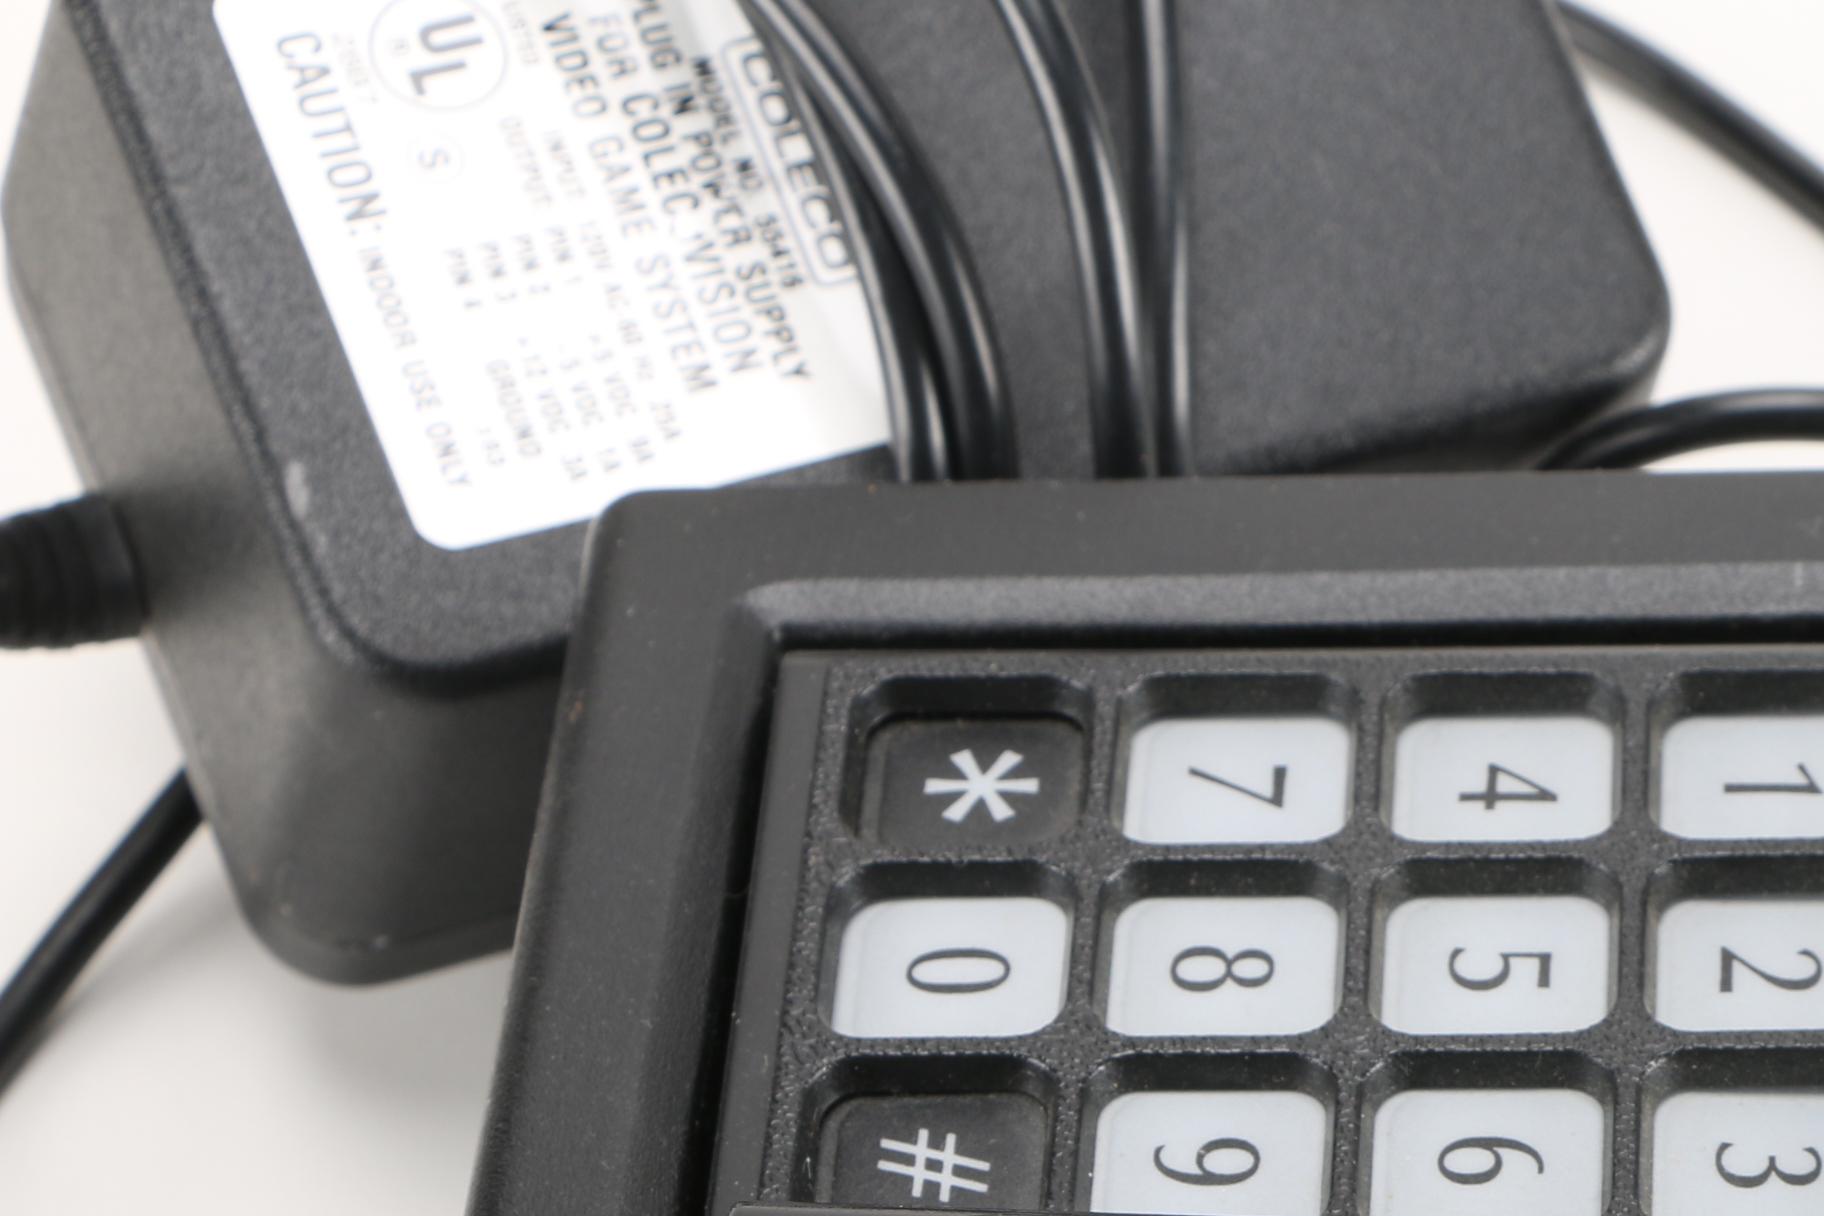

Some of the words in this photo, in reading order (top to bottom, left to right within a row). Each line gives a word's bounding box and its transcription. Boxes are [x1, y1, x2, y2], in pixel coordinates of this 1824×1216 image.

[407, 13, 484, 97] UL
[690, 57, 740, 142] MODEL
[540, 11, 608, 115] VIDEO
[589, 134, 654, 236] GAME
[636, 255, 719, 393] SYSTEM
[591, 17, 638, 80] FOR
[619, 91, 757, 372] COLECVISION
[664, 83, 702, 116] IN
[734, 260, 810, 378] SUPPLY
[274, 31, 389, 236] CAUTION:
[359, 246, 418, 348] INDOOR
[399, 360, 444, 413] USE
[424, 421, 471, 486] ONLY
[1189, 765, 1287, 808] 7
[1459, 764, 1557, 810] 4
[1724, 764, 1822, 794] 1
[906, 948, 1011, 994] 0
[1170, 946, 1274, 992] 8
[1449, 948, 1552, 991] 5
[1720, 947, 1822, 992] 2
[878, 1129, 990, 1202] #
[1154, 1138, 1260, 1186] 9
[1438, 1137, 1544, 1185] 6
[1716, 1143, 1822, 1188] 3
